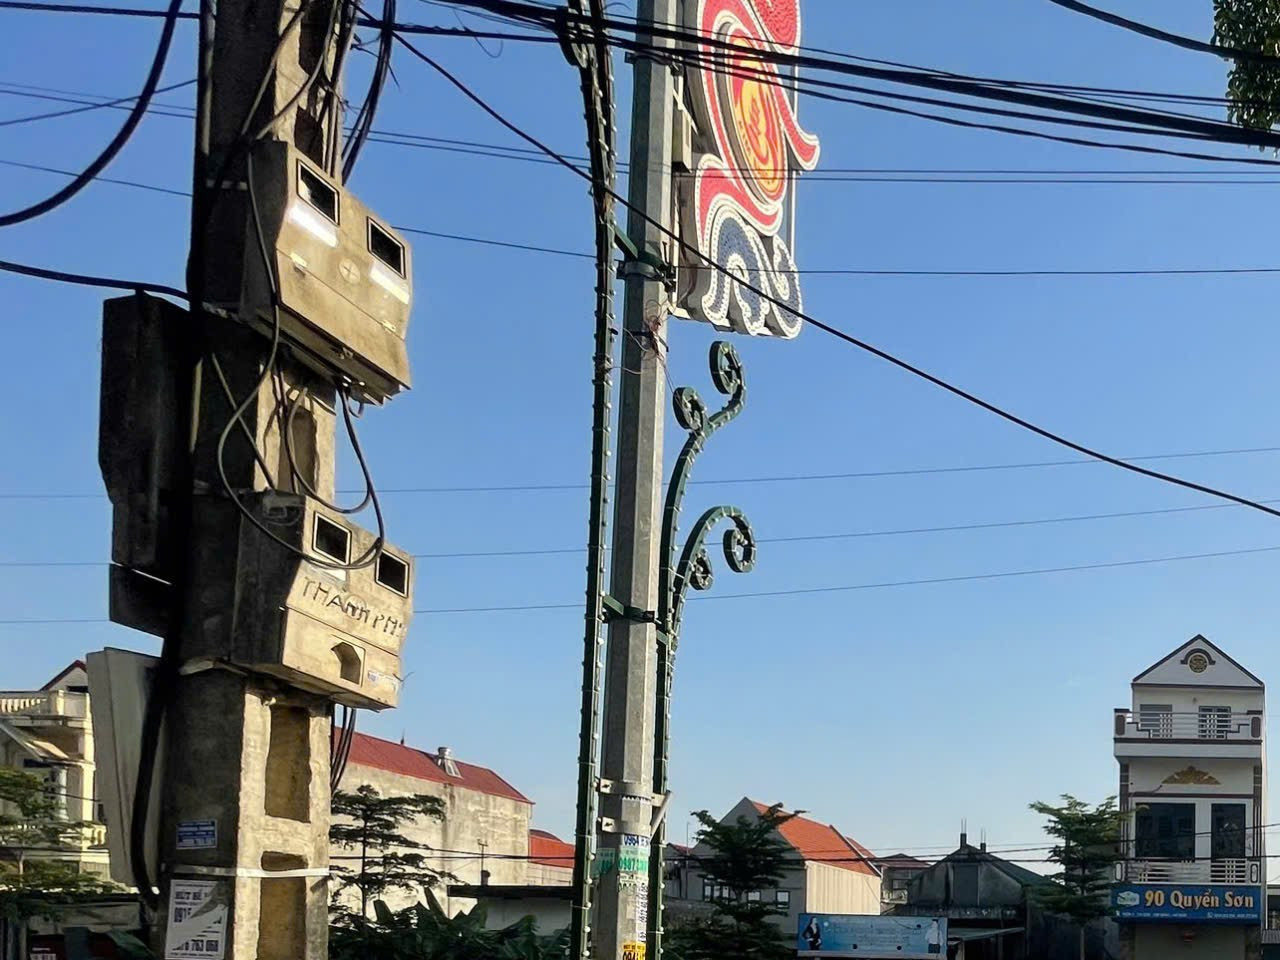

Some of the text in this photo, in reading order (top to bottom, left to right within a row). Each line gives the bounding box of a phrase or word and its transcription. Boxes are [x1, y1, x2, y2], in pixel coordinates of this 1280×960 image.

[1145, 890, 1165, 907] 90
[1170, 888, 1220, 909] Quyển
[1224, 891, 1254, 908] Sơn
